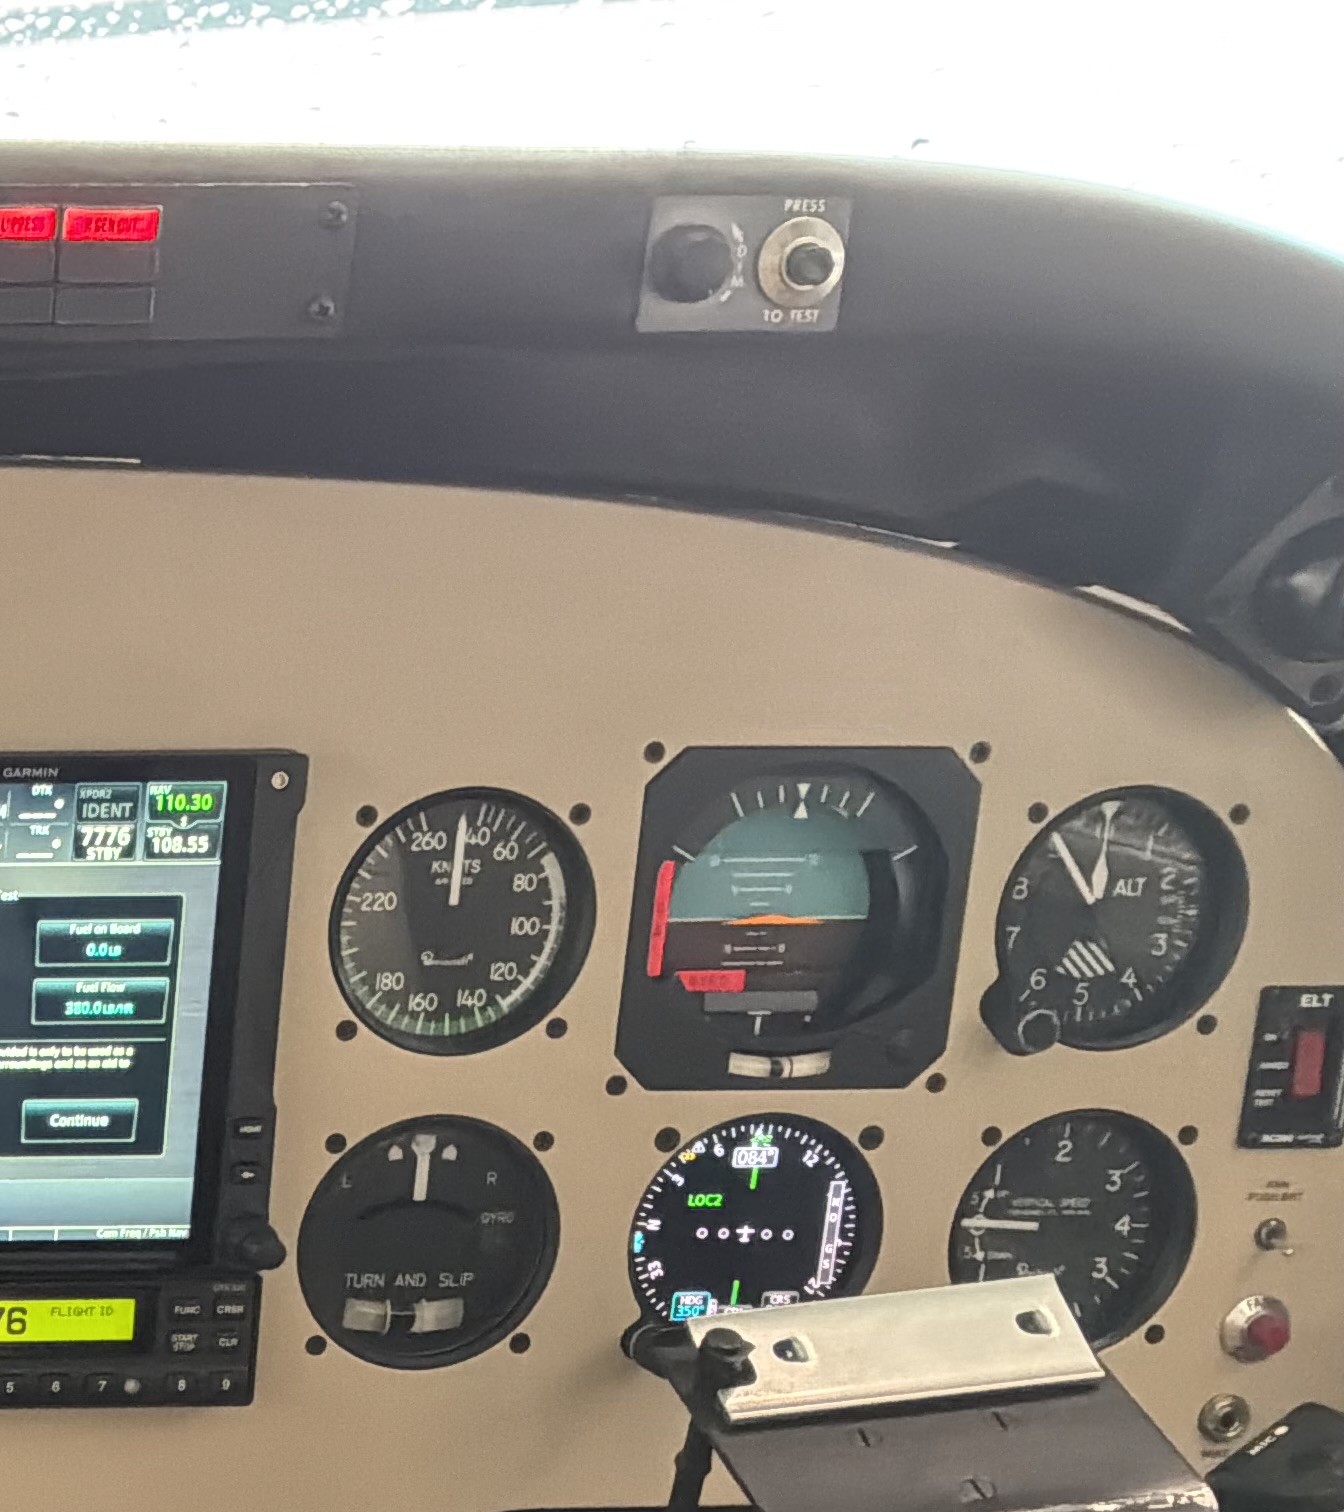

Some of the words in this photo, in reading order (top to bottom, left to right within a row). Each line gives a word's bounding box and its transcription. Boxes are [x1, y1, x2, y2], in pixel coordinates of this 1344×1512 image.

[784, 199, 826, 212] PRESS
[762, 309, 783, 322] TO
[790, 309, 820, 322] TEST
[3, 768, 59, 778] GARMIN
[82, 803, 134, 819] IDENT
[155, 794, 213, 812] 110.30
[80, 826, 130, 846] 7776
[152, 836, 209, 853] 108.55
[411, 831, 447, 852] 260
[86, 846, 122, 859] STBY
[513, 874, 537, 892] 80
[1113, 876, 1148, 897] ALT
[361, 892, 397, 911] 220
[511, 917, 541, 936] 100
[376, 972, 404, 990] 180
[456, 989, 486, 1007] 140
[1300, 994, 1334, 1008] ELT
[50, 1113, 109, 1128] Continue
[688, 1193, 723, 1207] LOC2
[344, 1272, 385, 1289] TURN
[394, 1273, 426, 1288] AND
[438, 1271, 475, 1288] SLIP
